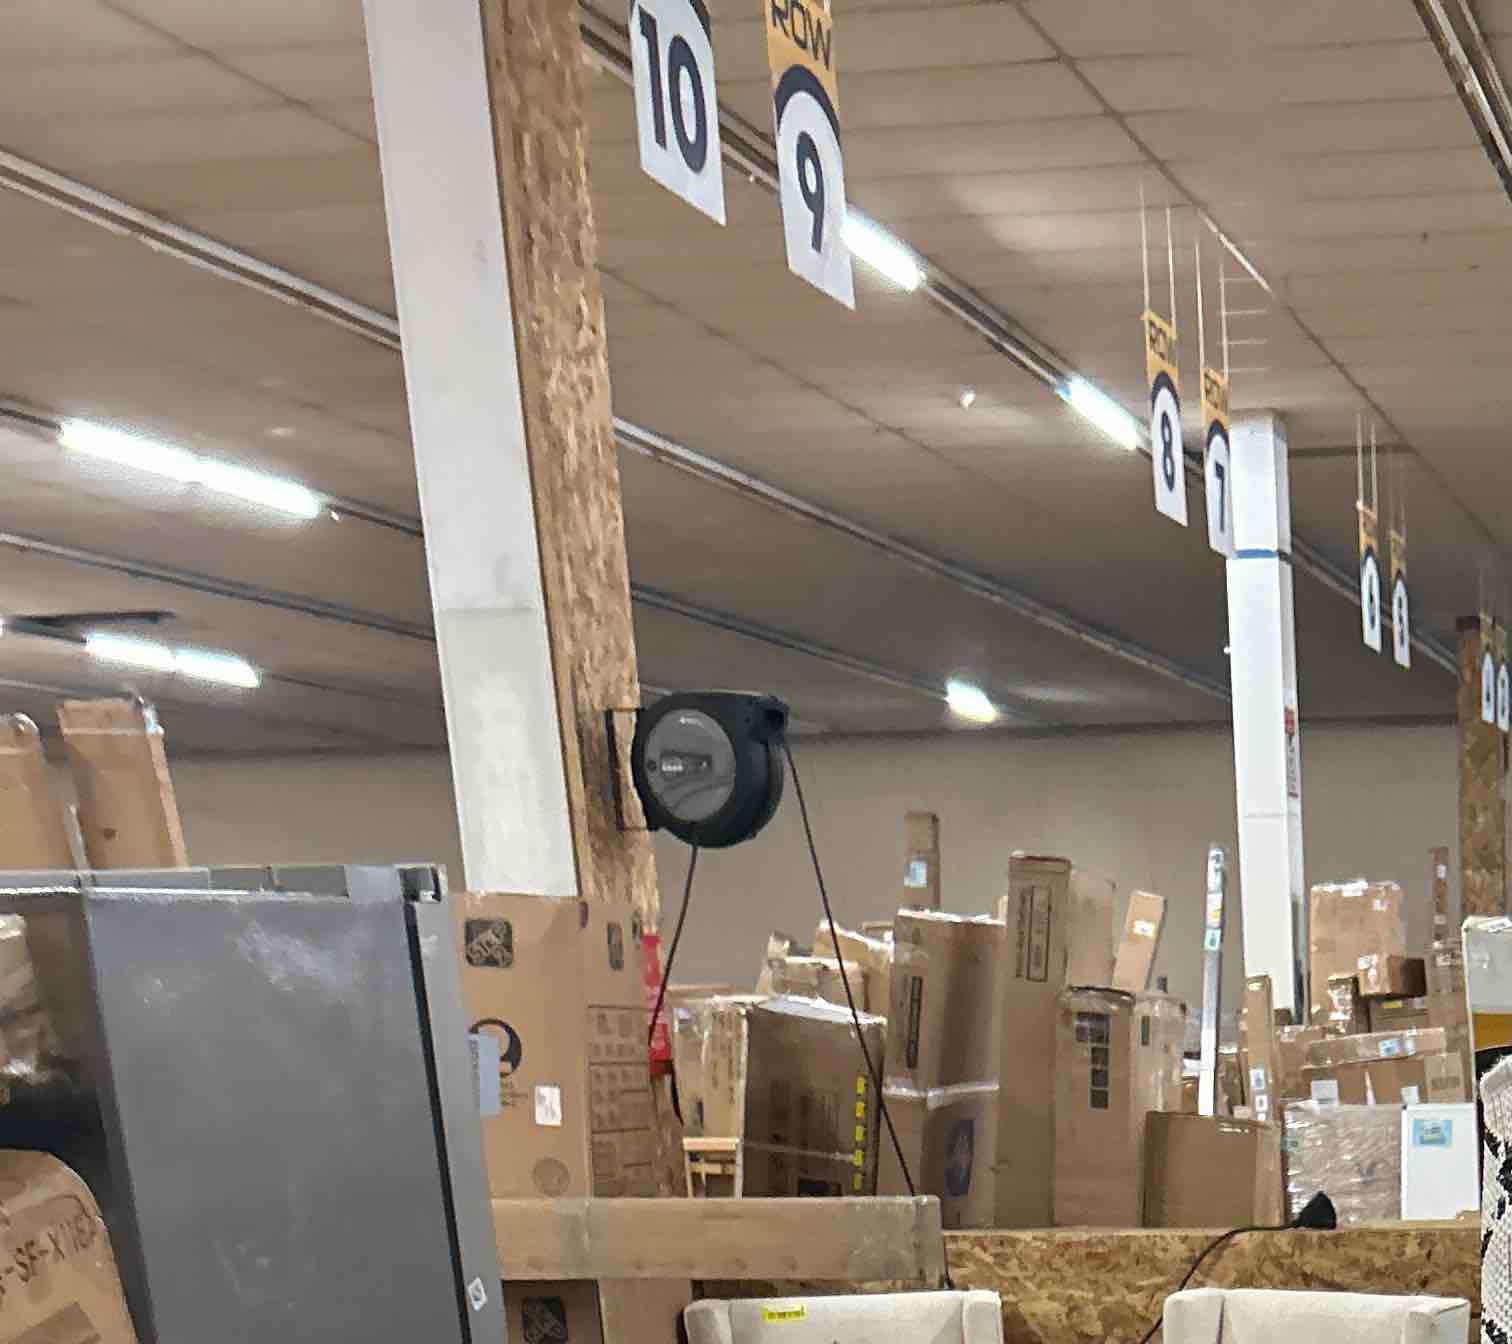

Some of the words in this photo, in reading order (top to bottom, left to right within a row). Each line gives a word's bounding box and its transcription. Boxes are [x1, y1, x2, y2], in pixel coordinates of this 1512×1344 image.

[638, 5, 708, 174] 10
[796, 131, 824, 253] 9
[1161, 410, 1175, 491] 8
[1214, 462, 1225, 533] 7
